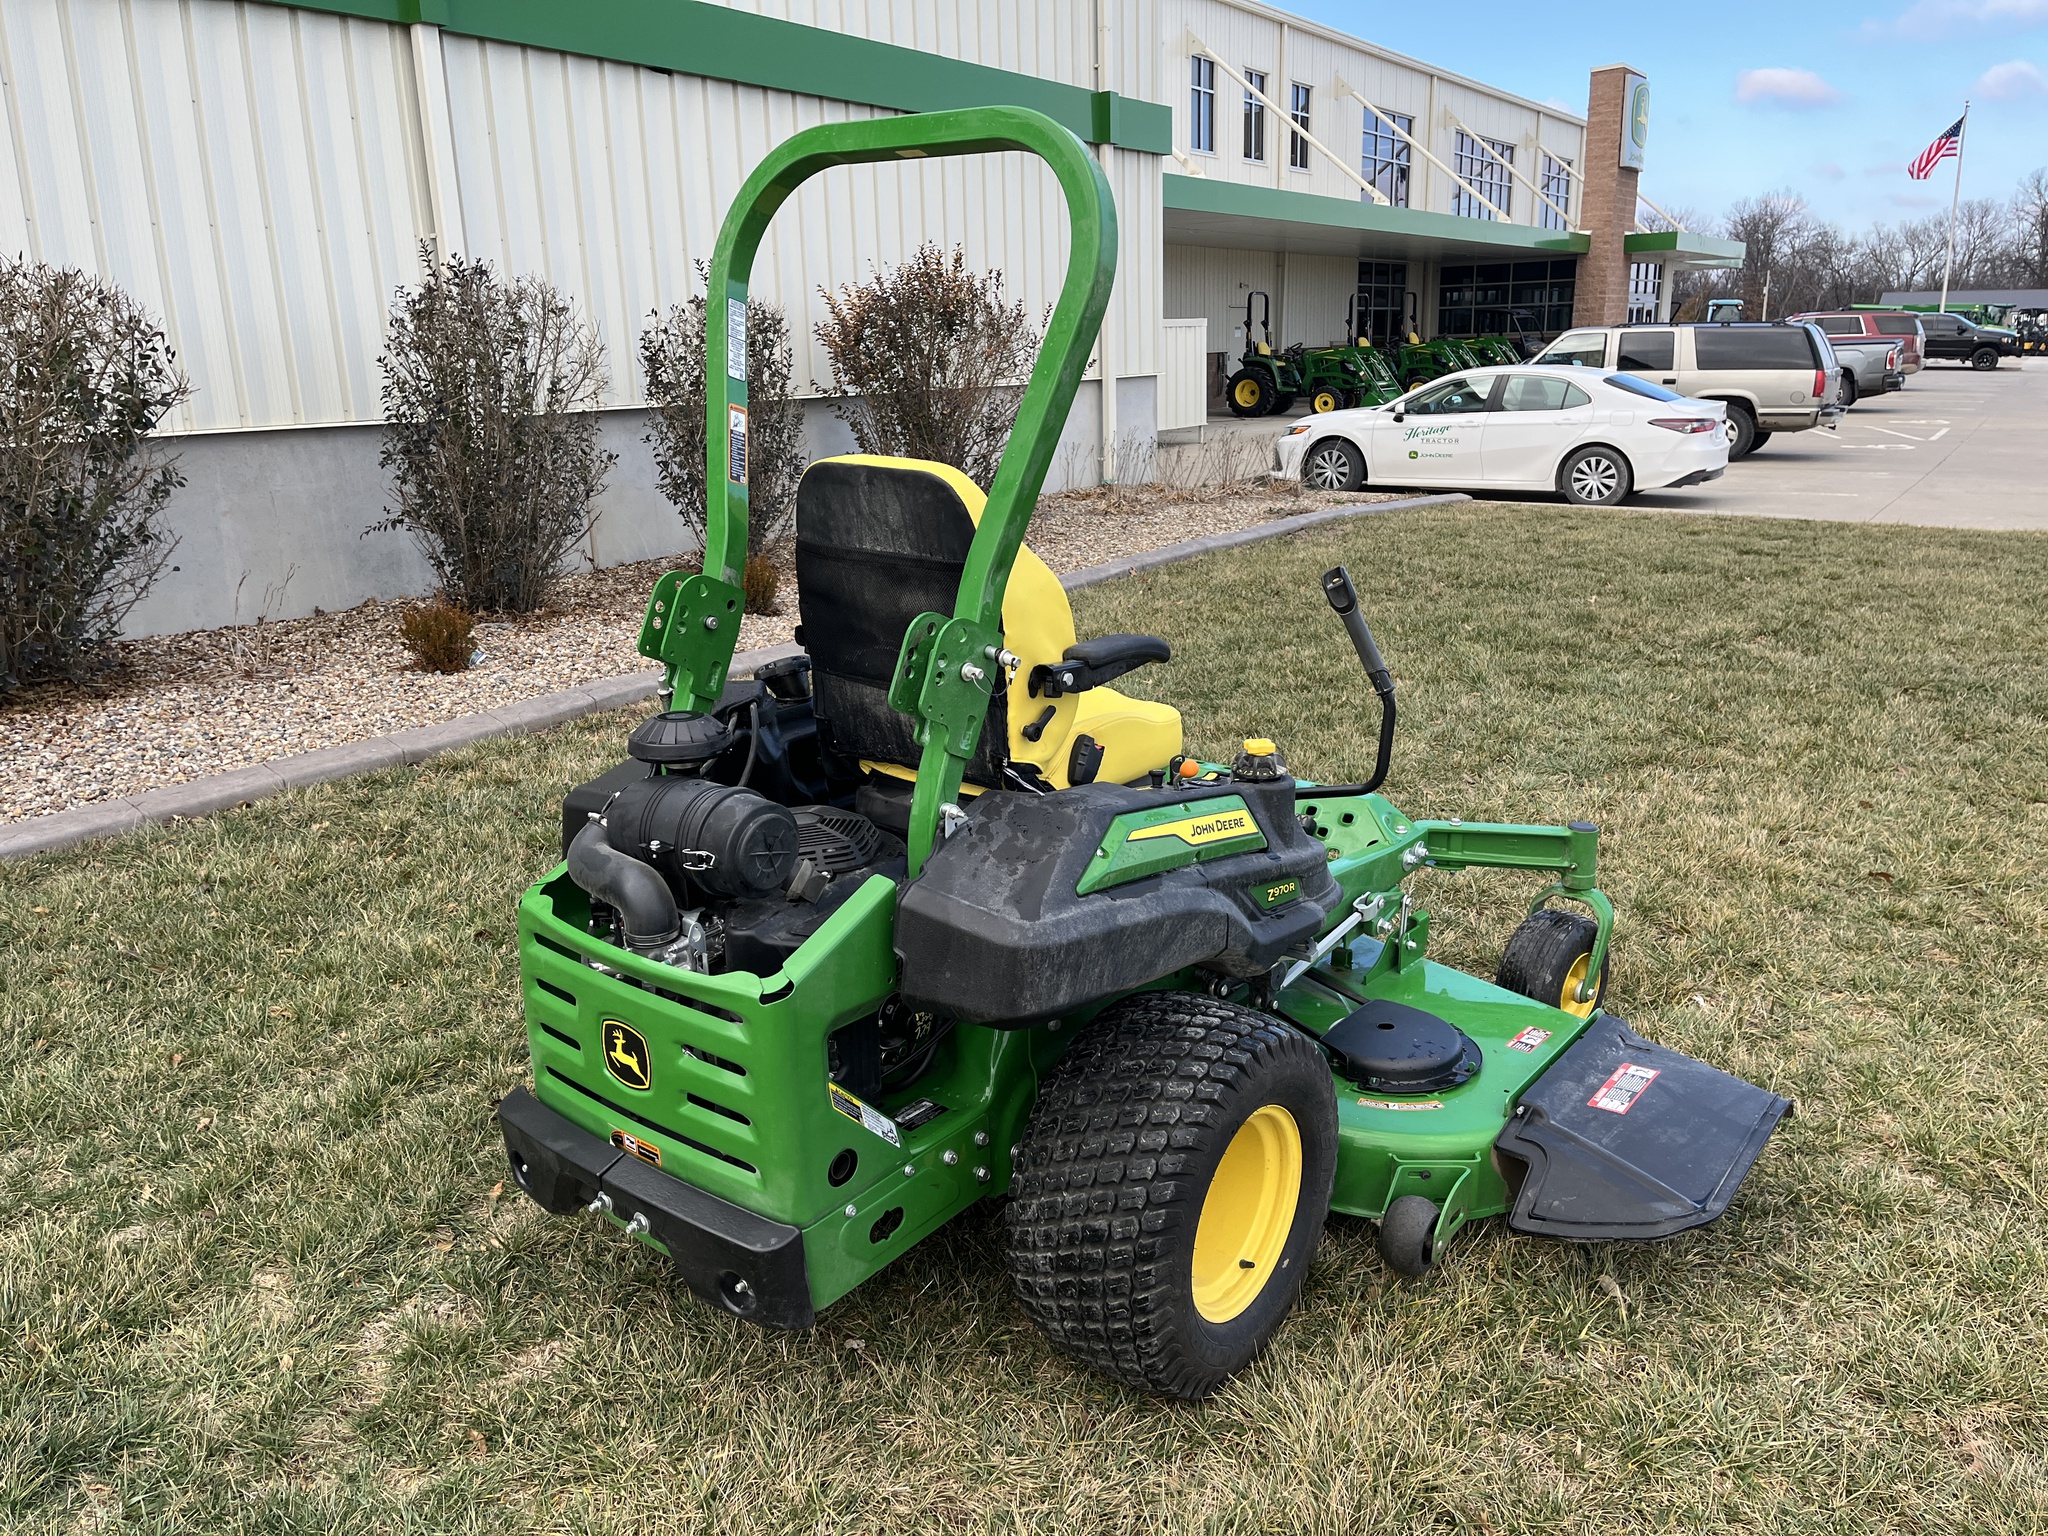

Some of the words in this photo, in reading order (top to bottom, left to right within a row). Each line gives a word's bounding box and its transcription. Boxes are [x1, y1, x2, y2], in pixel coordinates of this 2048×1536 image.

[1403, 425, 1452, 441] Heritage
[1191, 823, 1215, 837] JOHN
[1215, 817, 1245, 831] DEERE
[1267, 882, 1295, 901] Z970R
